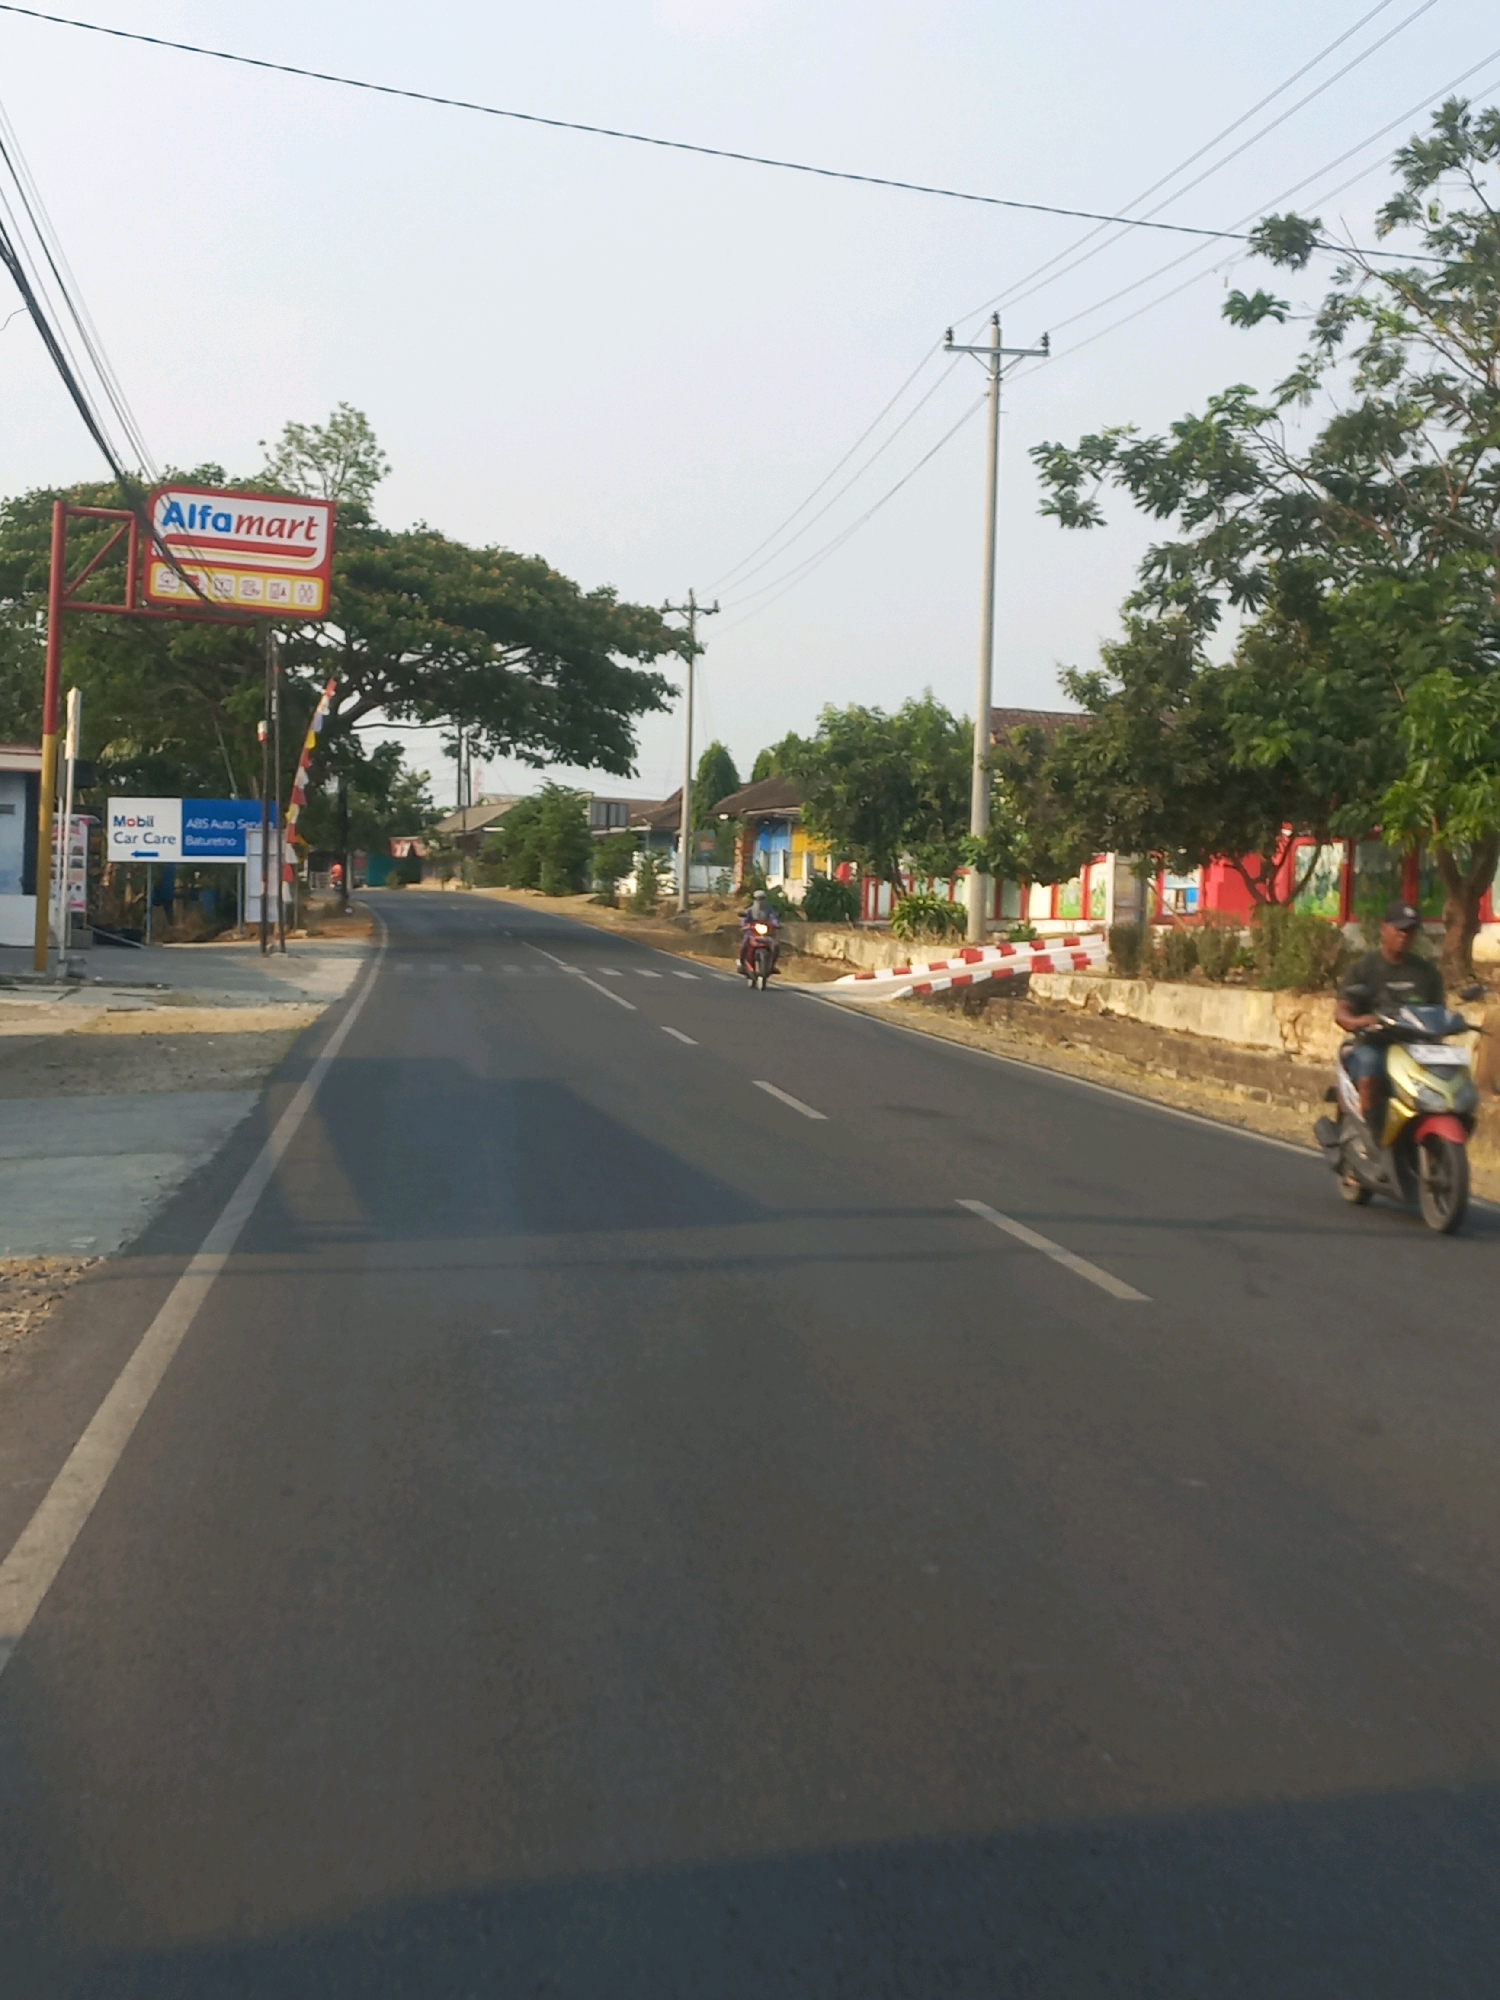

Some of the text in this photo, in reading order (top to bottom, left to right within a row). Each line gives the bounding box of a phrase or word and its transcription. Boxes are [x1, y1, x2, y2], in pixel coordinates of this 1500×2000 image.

[162, 501, 319, 541] Alfamart
[113, 815, 154, 828] Mobil
[186, 818, 275, 830] ABS Auto Servie
[113, 832, 177, 845] Car Care
